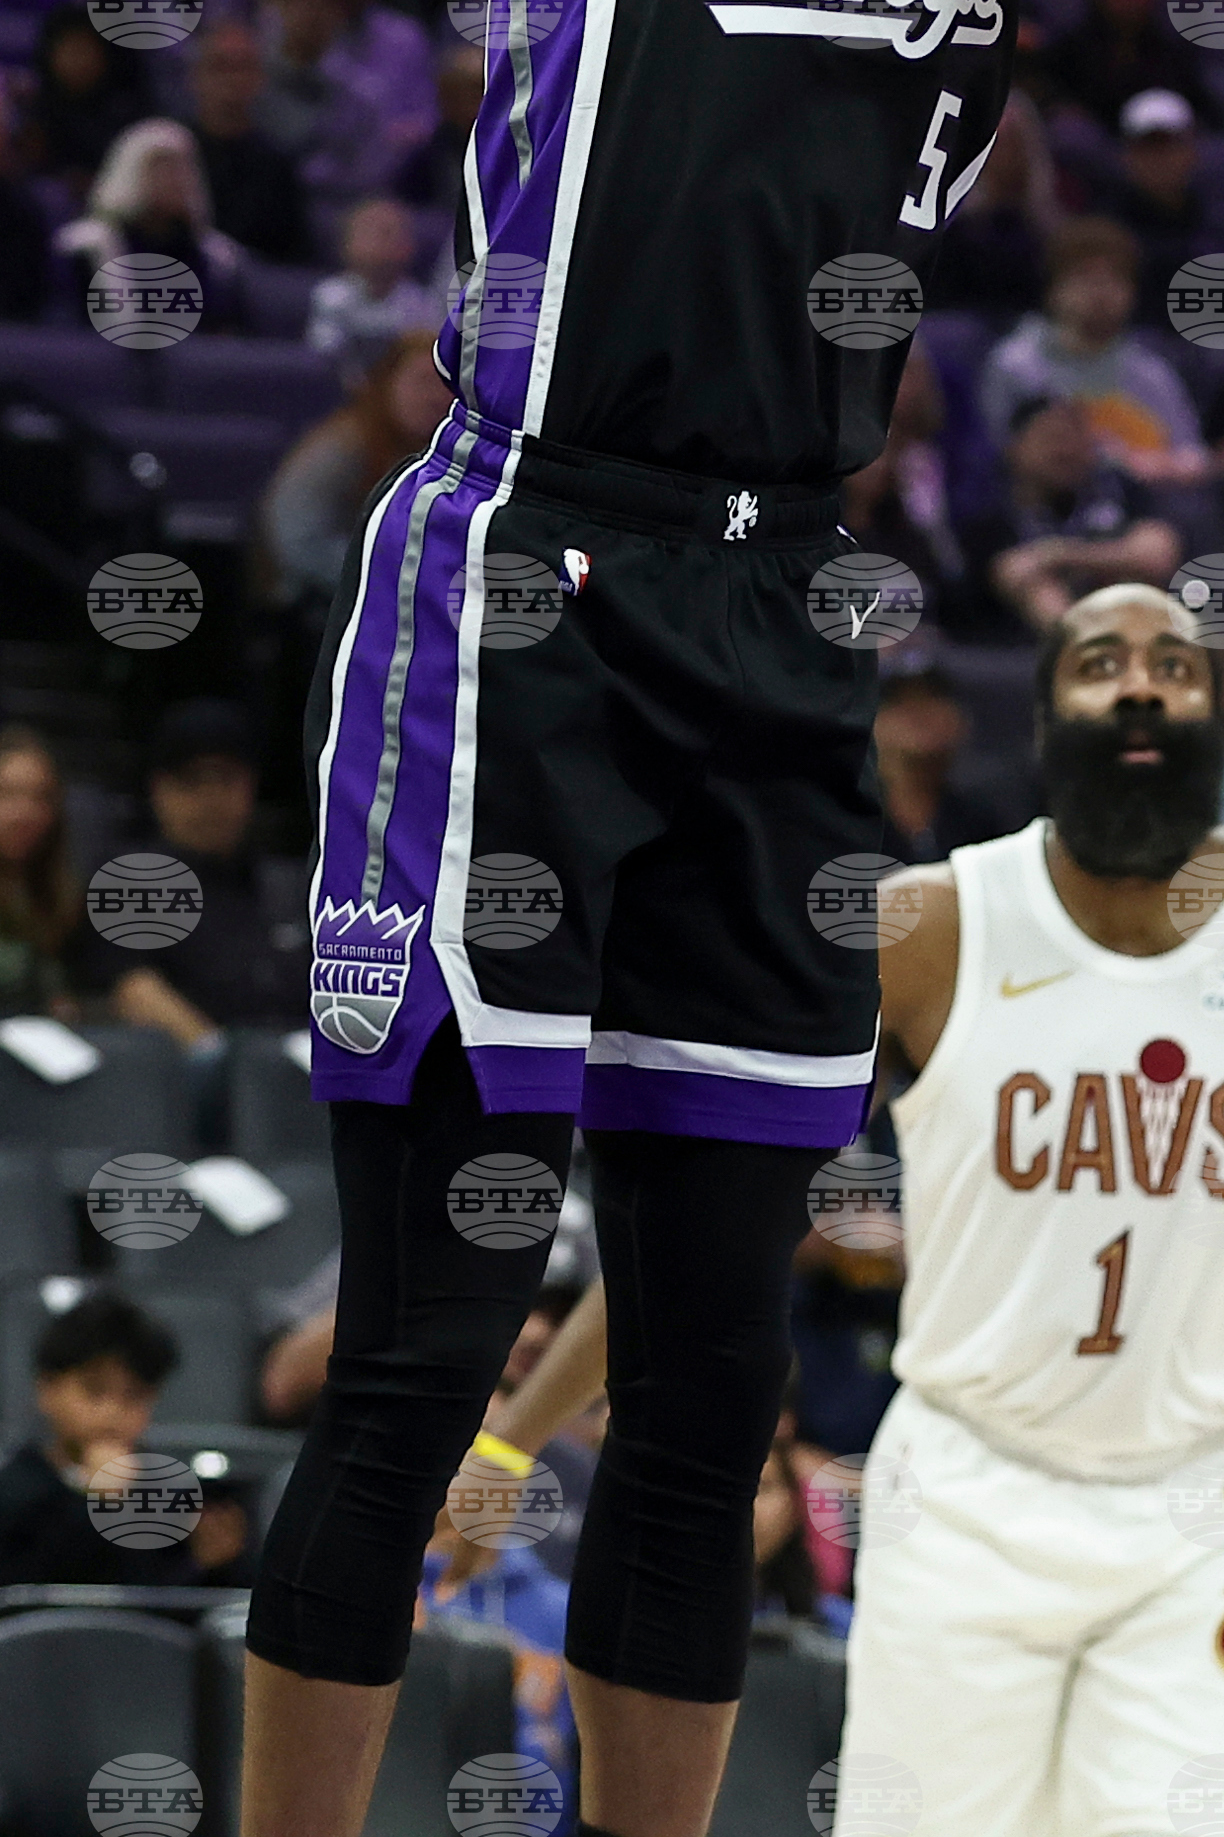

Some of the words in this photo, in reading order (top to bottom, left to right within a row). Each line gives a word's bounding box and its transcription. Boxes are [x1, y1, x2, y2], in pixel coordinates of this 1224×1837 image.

[318, 942, 403, 962] SACRAMENTO
[314, 962, 405, 998] KINGS
[1075, 1227, 1131, 1357] 1
